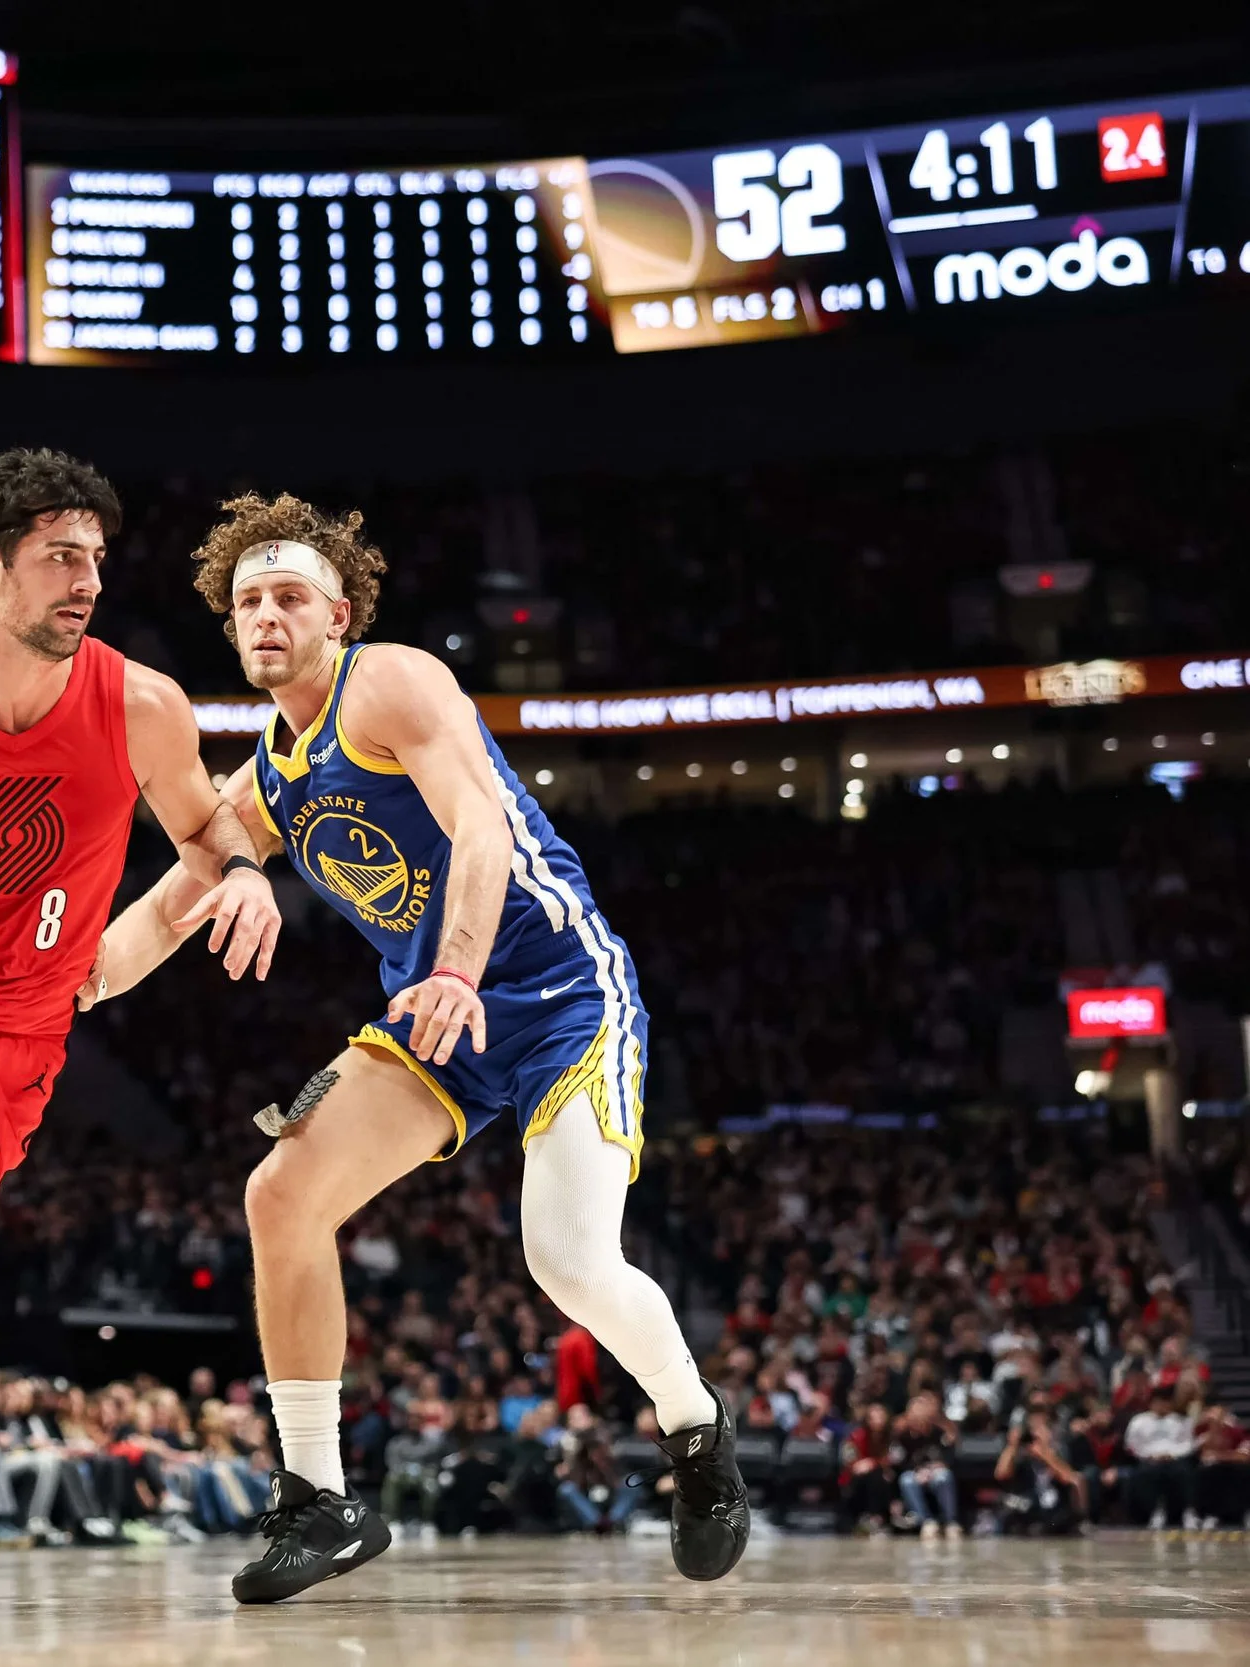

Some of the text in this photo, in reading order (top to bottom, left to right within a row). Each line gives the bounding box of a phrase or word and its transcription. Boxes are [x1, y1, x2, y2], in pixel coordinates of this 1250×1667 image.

[908, 117, 1165, 201] 4:11 2.4
[712, 143, 847, 262] 52
[934, 228, 1149, 303] moda
[771, 287, 796, 320] 2
[866, 278, 885, 310] 1
[289, 796, 366, 859] OLDEN STATE
[349, 827, 379, 860] 2
[33, 888, 67, 951] 8
[355, 868, 431, 933] WARRIORS
